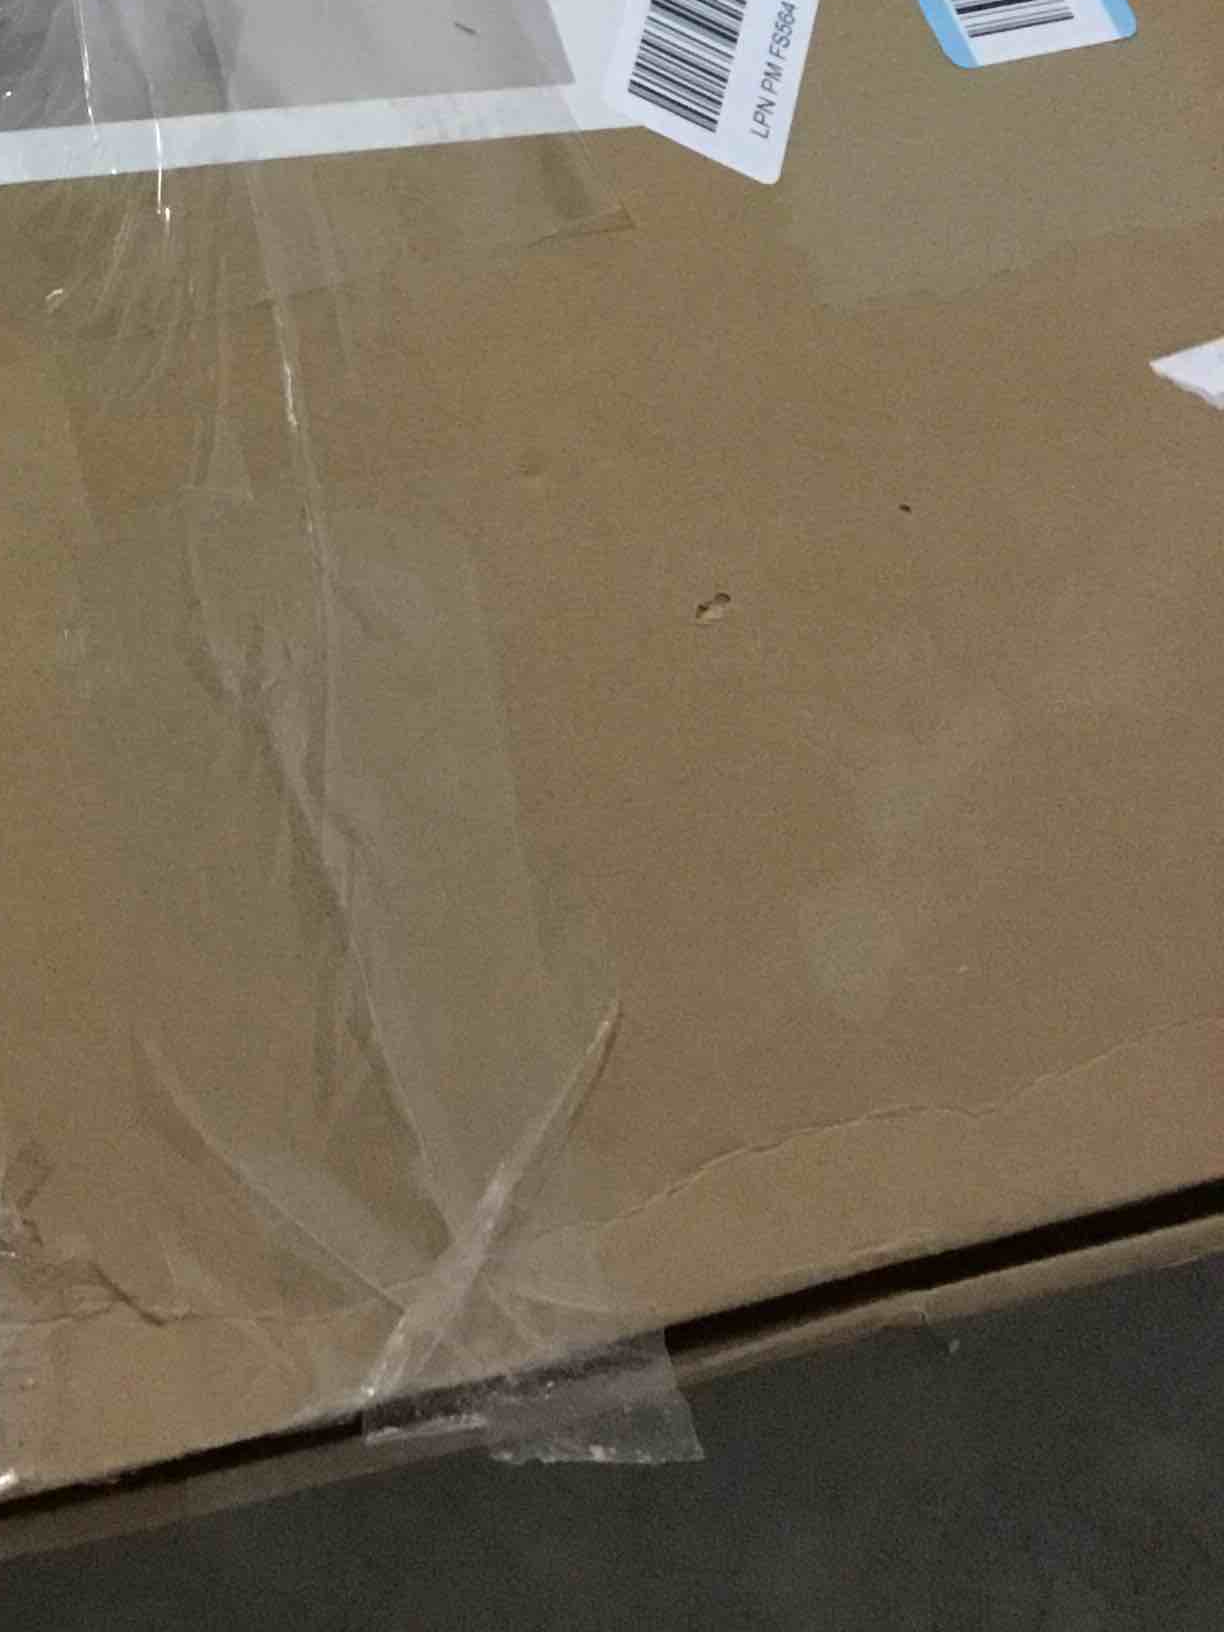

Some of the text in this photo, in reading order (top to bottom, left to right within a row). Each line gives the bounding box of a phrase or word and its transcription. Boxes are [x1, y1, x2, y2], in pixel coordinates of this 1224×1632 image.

[768, 0, 797, 62] FS564
[760, 61, 784, 96] PM
[750, 96, 777, 140] LPN
